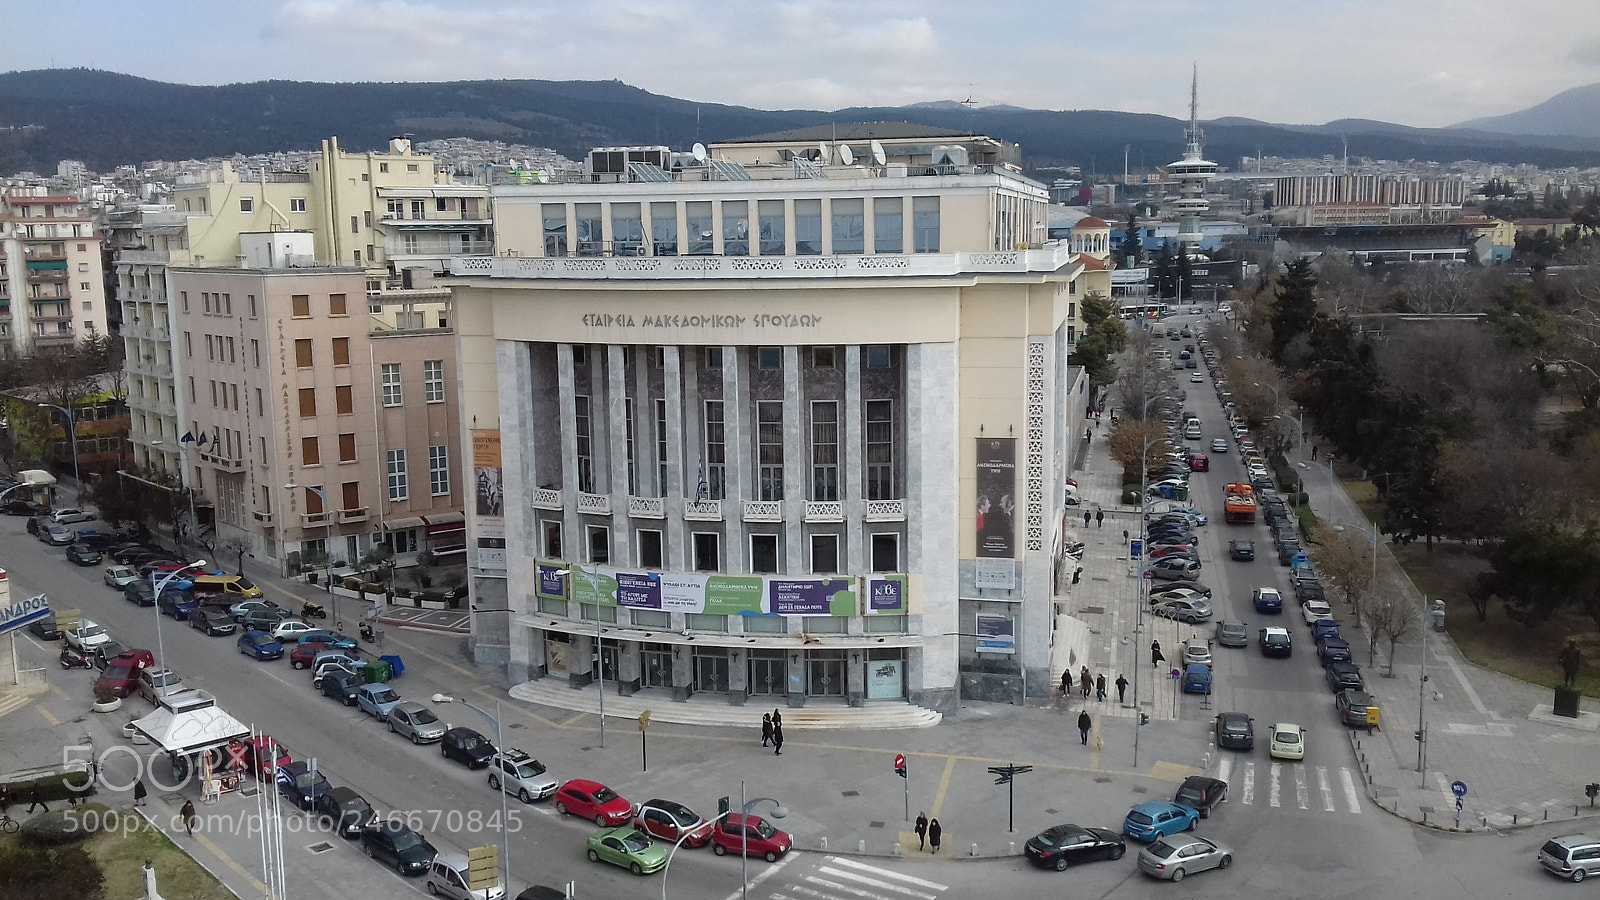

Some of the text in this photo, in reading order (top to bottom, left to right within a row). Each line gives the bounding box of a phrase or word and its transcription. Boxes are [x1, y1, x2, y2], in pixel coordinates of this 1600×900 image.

[582, 313, 822, 328] ΕΤΑΙΡΕΙΑ ΜΑΚΕΔΟΝΙΚΩΝ ΣΠΟΥΔΩΝ
